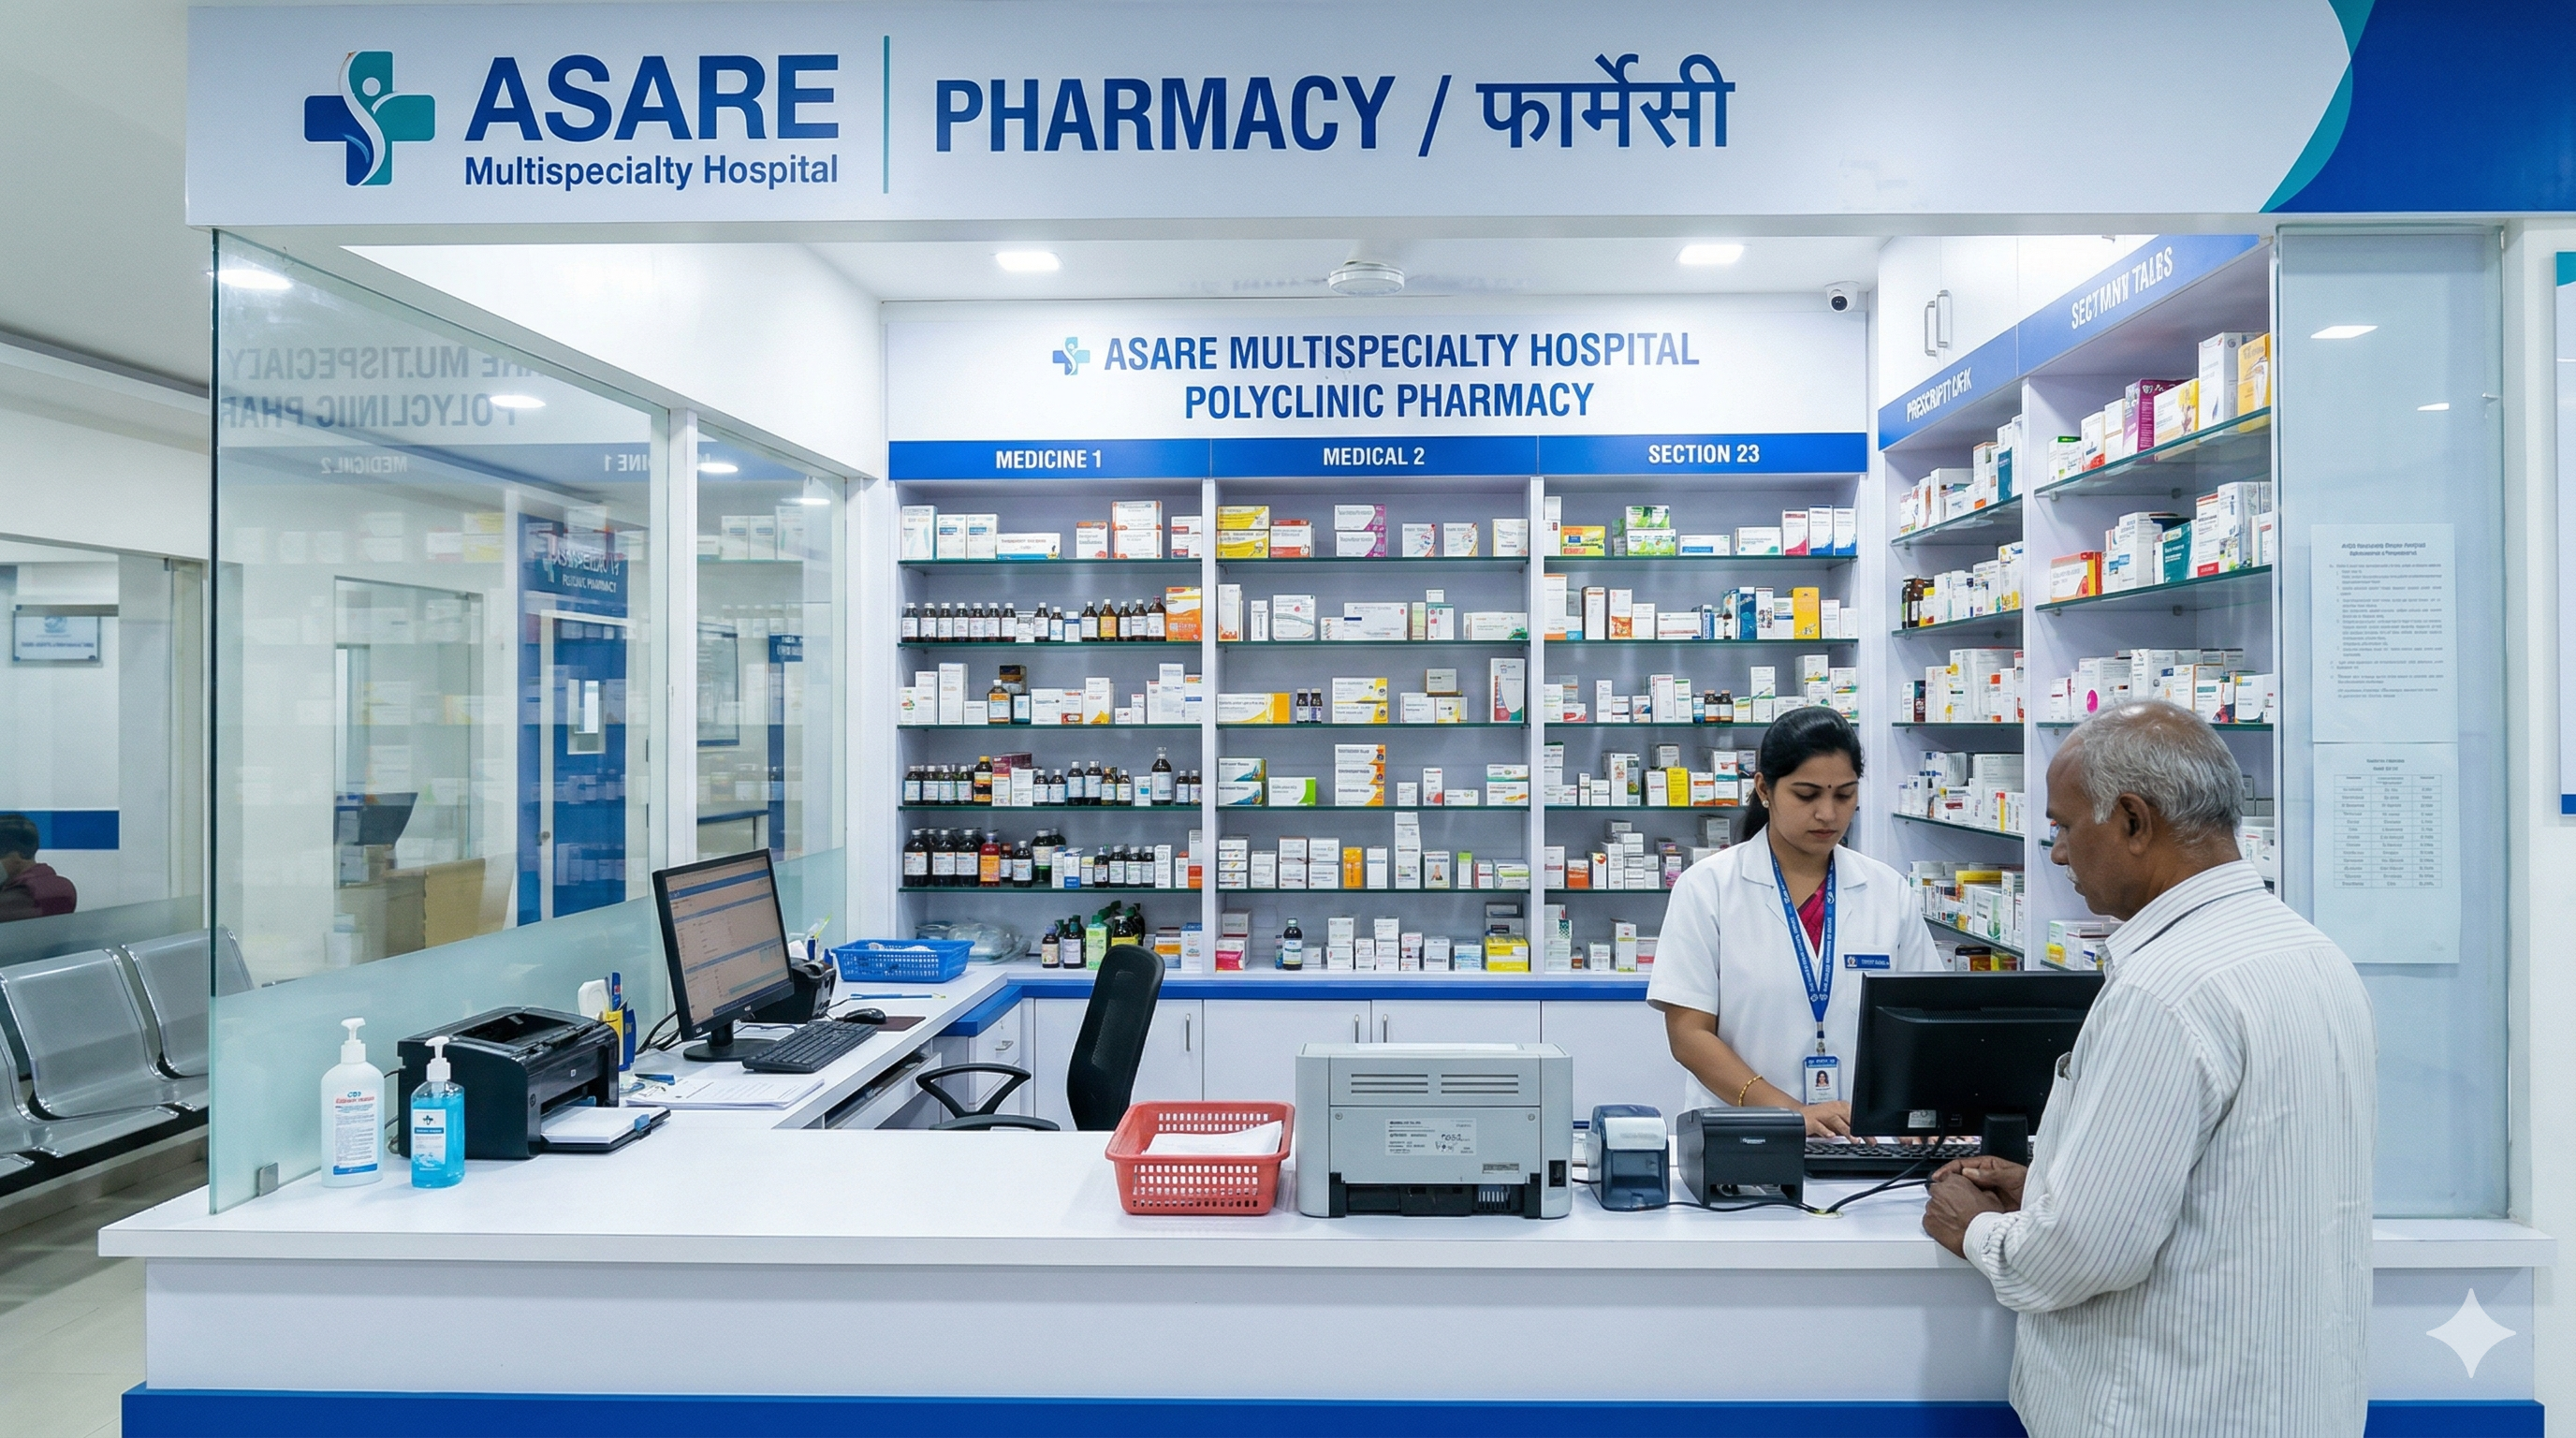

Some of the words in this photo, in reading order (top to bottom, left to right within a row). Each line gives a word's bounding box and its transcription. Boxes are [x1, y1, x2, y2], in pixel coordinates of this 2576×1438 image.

[464, 53, 839, 142] ASARE
[936, 75, 1397, 153] PHARMACY
[1418, 74, 1452, 157] /
[1475, 52, 1736, 149] फार्मेसी
[465, 154, 693, 191] Multispecialty
[704, 154, 838, 189] Hospital
[1105, 336, 1218, 371] ASARE
[1230, 333, 1519, 370] MULTISPECIALTY
[1530, 331, 1701, 367] HOSPITAL
[1185, 383, 1384, 419] POLYCLINIC
[1397, 382, 1595, 418] PHARMACY
[996, 449, 1088, 469] MEDICINE
[1091, 449, 1103, 468] 1
[1323, 447, 1409, 466] MEDICAL
[1413, 447, 1426, 465] 2
[1648, 444, 1731, 463] SECTION
[1736, 444, 1761, 463] 23
